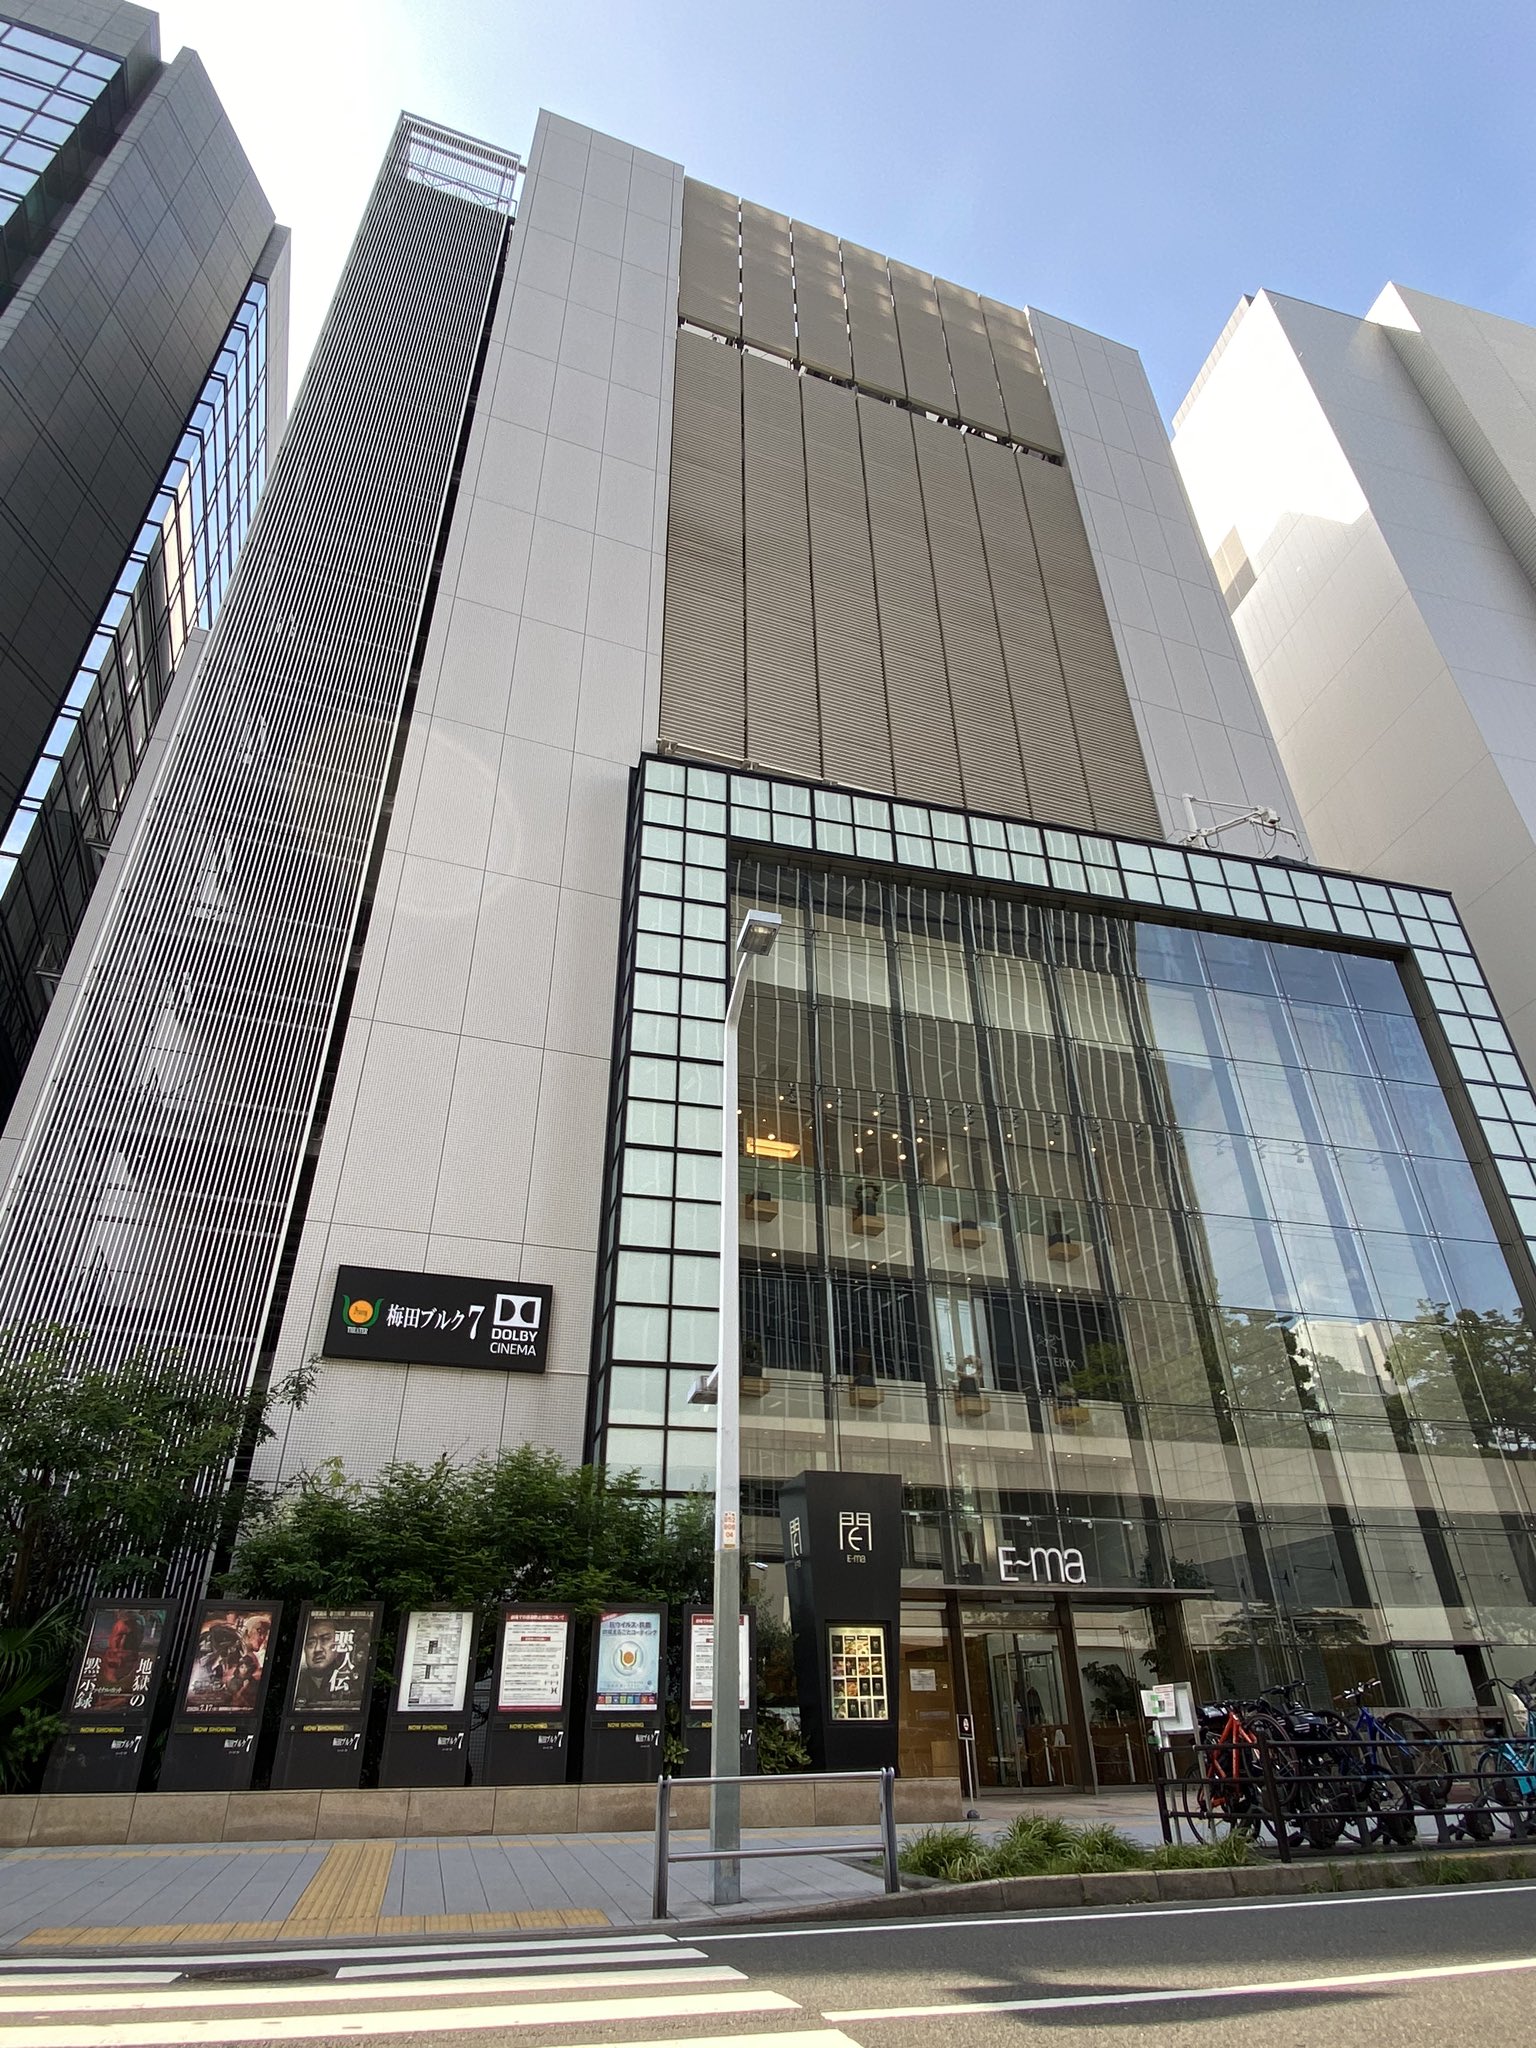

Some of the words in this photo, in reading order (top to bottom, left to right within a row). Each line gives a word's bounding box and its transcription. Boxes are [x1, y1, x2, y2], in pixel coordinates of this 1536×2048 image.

[386, 1303, 485, 1340] 梅田ブルク7
[491, 1328, 538, 1342] DOLBY
[489, 1342, 536, 1356] CINEMA
[74, 1657, 102, 1709] 黙示録
[130, 1657, 153, 1707] 地獄の
